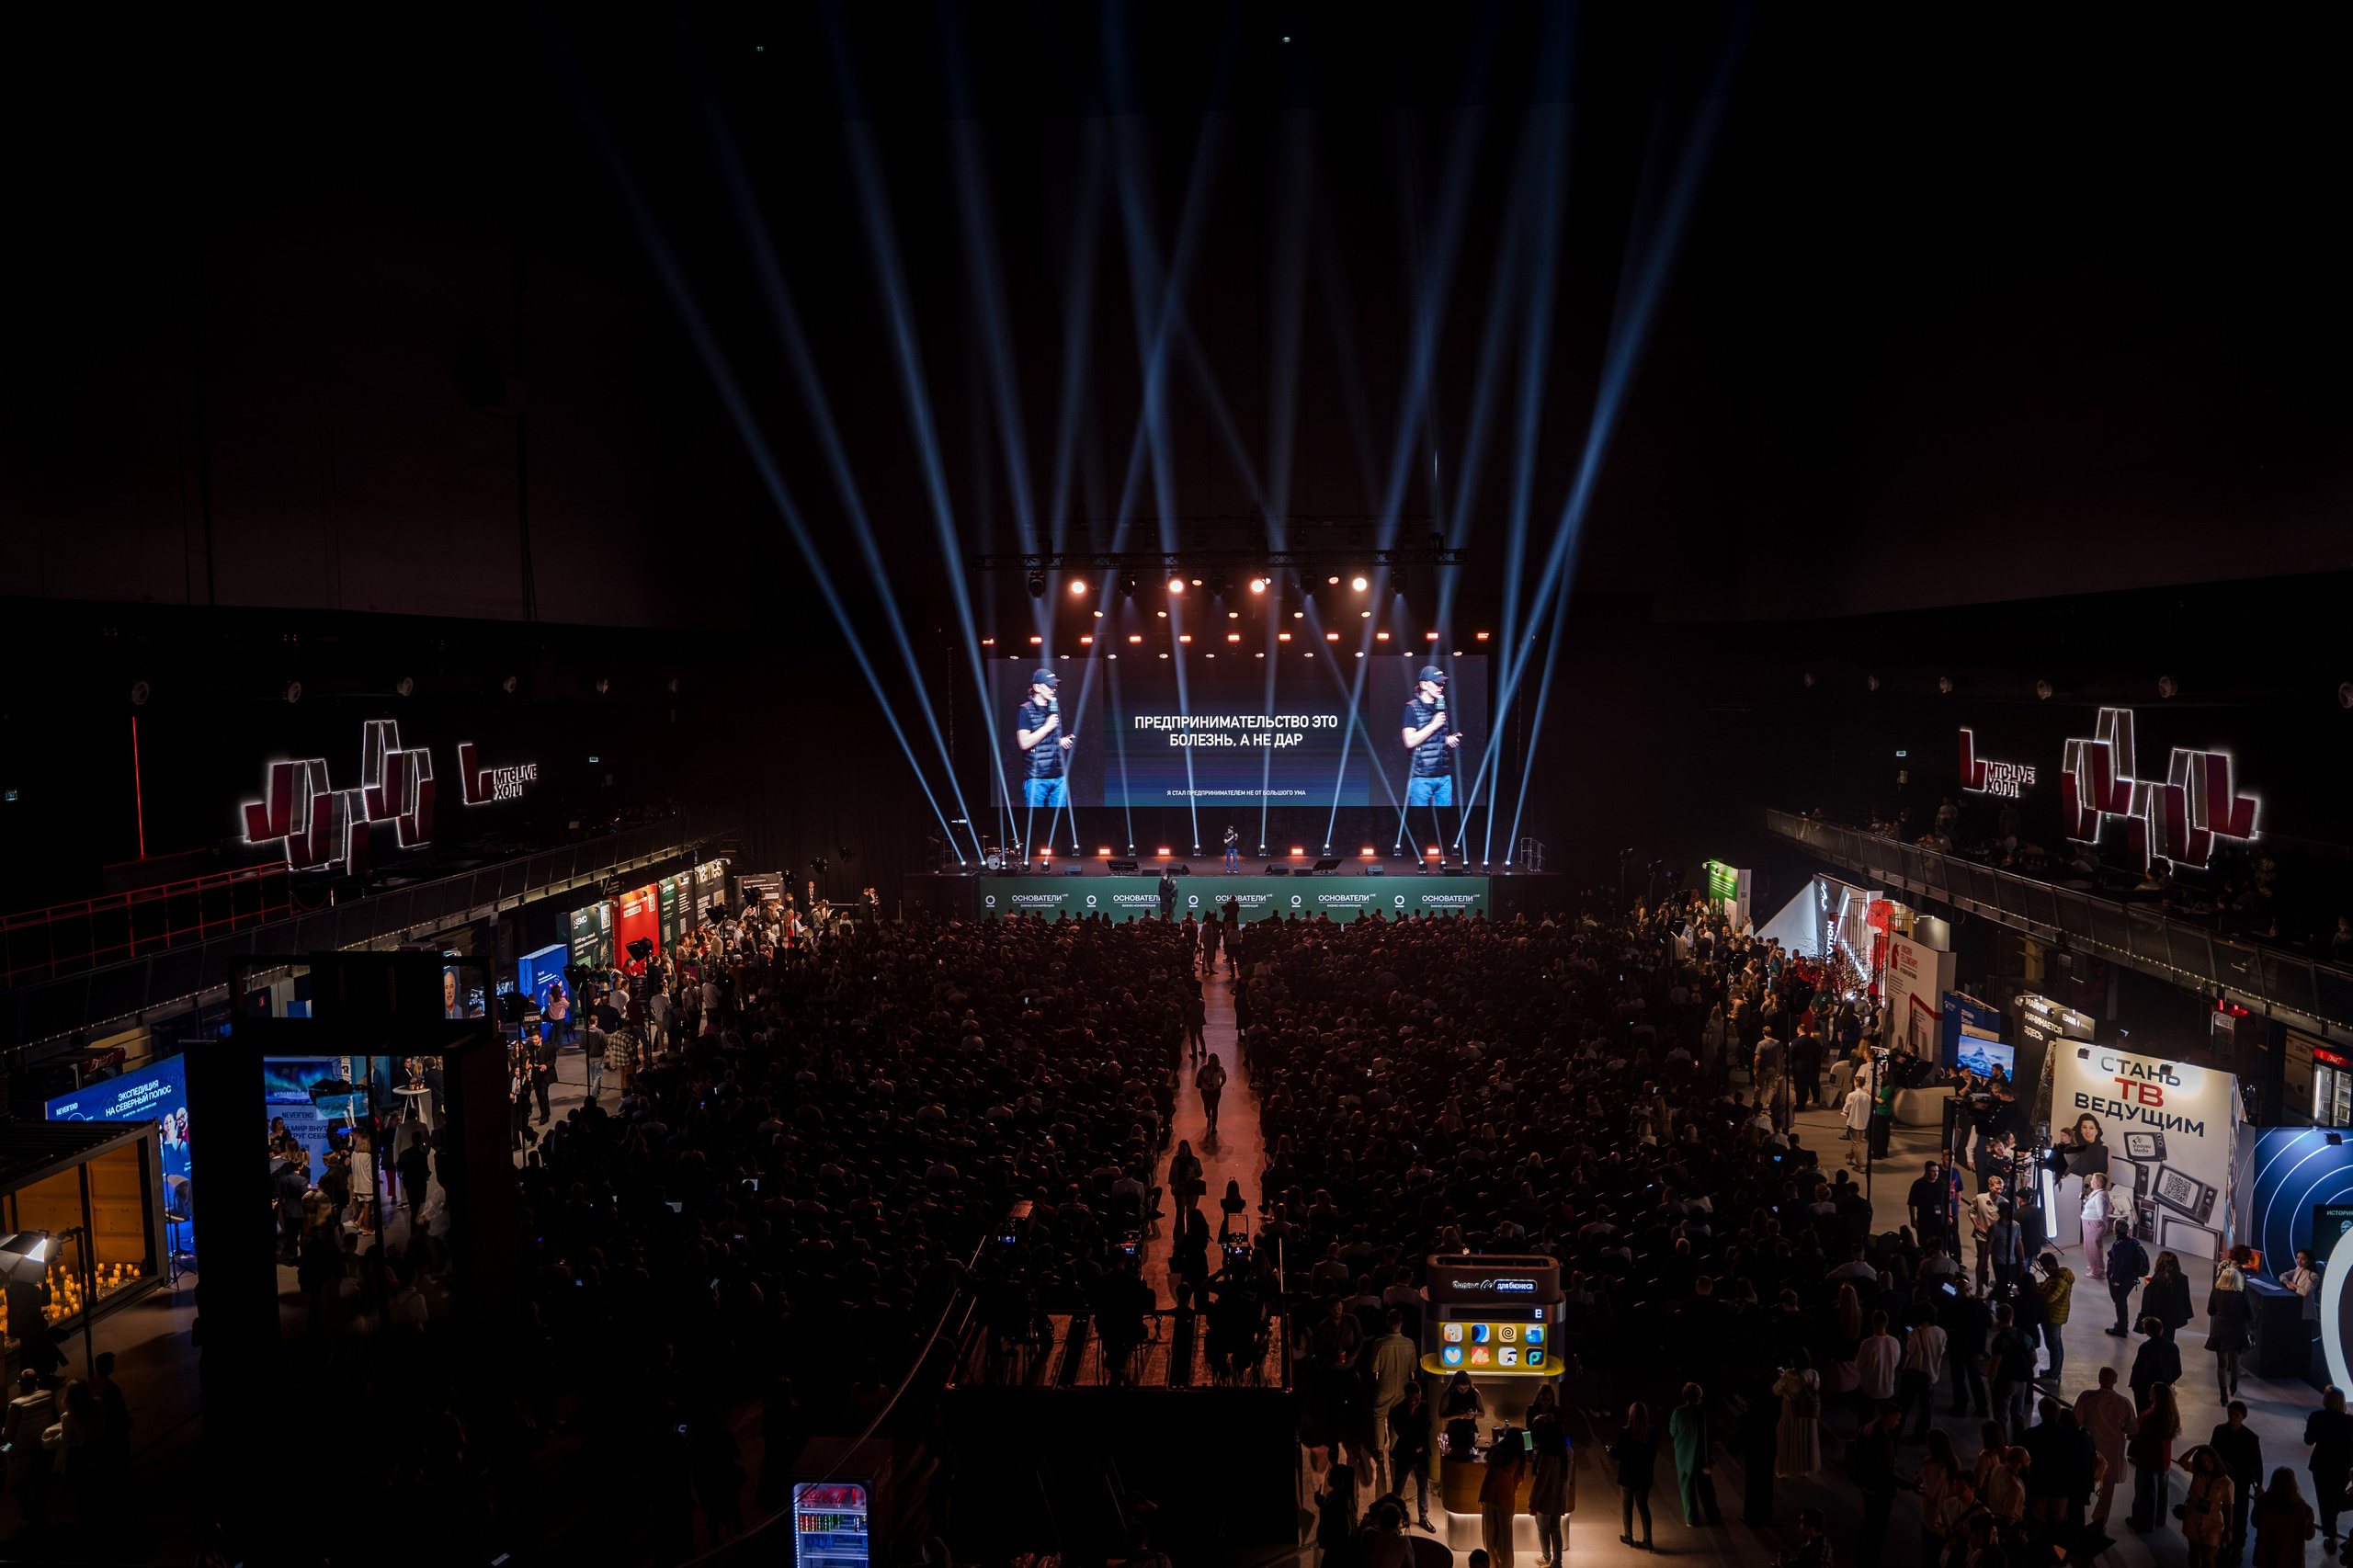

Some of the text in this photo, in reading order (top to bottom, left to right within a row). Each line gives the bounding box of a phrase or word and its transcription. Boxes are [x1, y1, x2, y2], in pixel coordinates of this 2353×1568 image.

[1134, 715, 1338, 731] ПРЕДПРИНИМАТЕЛЬСТВО ЭТО
[1169, 733, 1303, 748] БОЛЕЗНЬ, А НЕ ДАР
[493, 781, 524, 800] ХОЛЛ
[1987, 778, 2020, 798] ХОЛЛ
[2023, 1025, 2044, 1040] ЗДЕСЬ
[2024, 1011, 2063, 1036] НАЧИНАЕТСЯ
[2101, 1056, 2181, 1086] СТАНЬ
[118, 1079, 159, 1102] ЭКСПЕДИЦИЯ
[2114, 1076, 2164, 1108] ТВ
[105, 1107, 116, 1118] НА
[116, 1093, 149, 1114] СЕВЕРНЫЙ
[149, 1085, 172, 1101] ПОЛЮС
[2075, 1092, 2204, 1138] ВЕДУЩИМ
[1496, 1282, 1509, 1290] для
[1509, 1281, 1533, 1290] бизнеса
